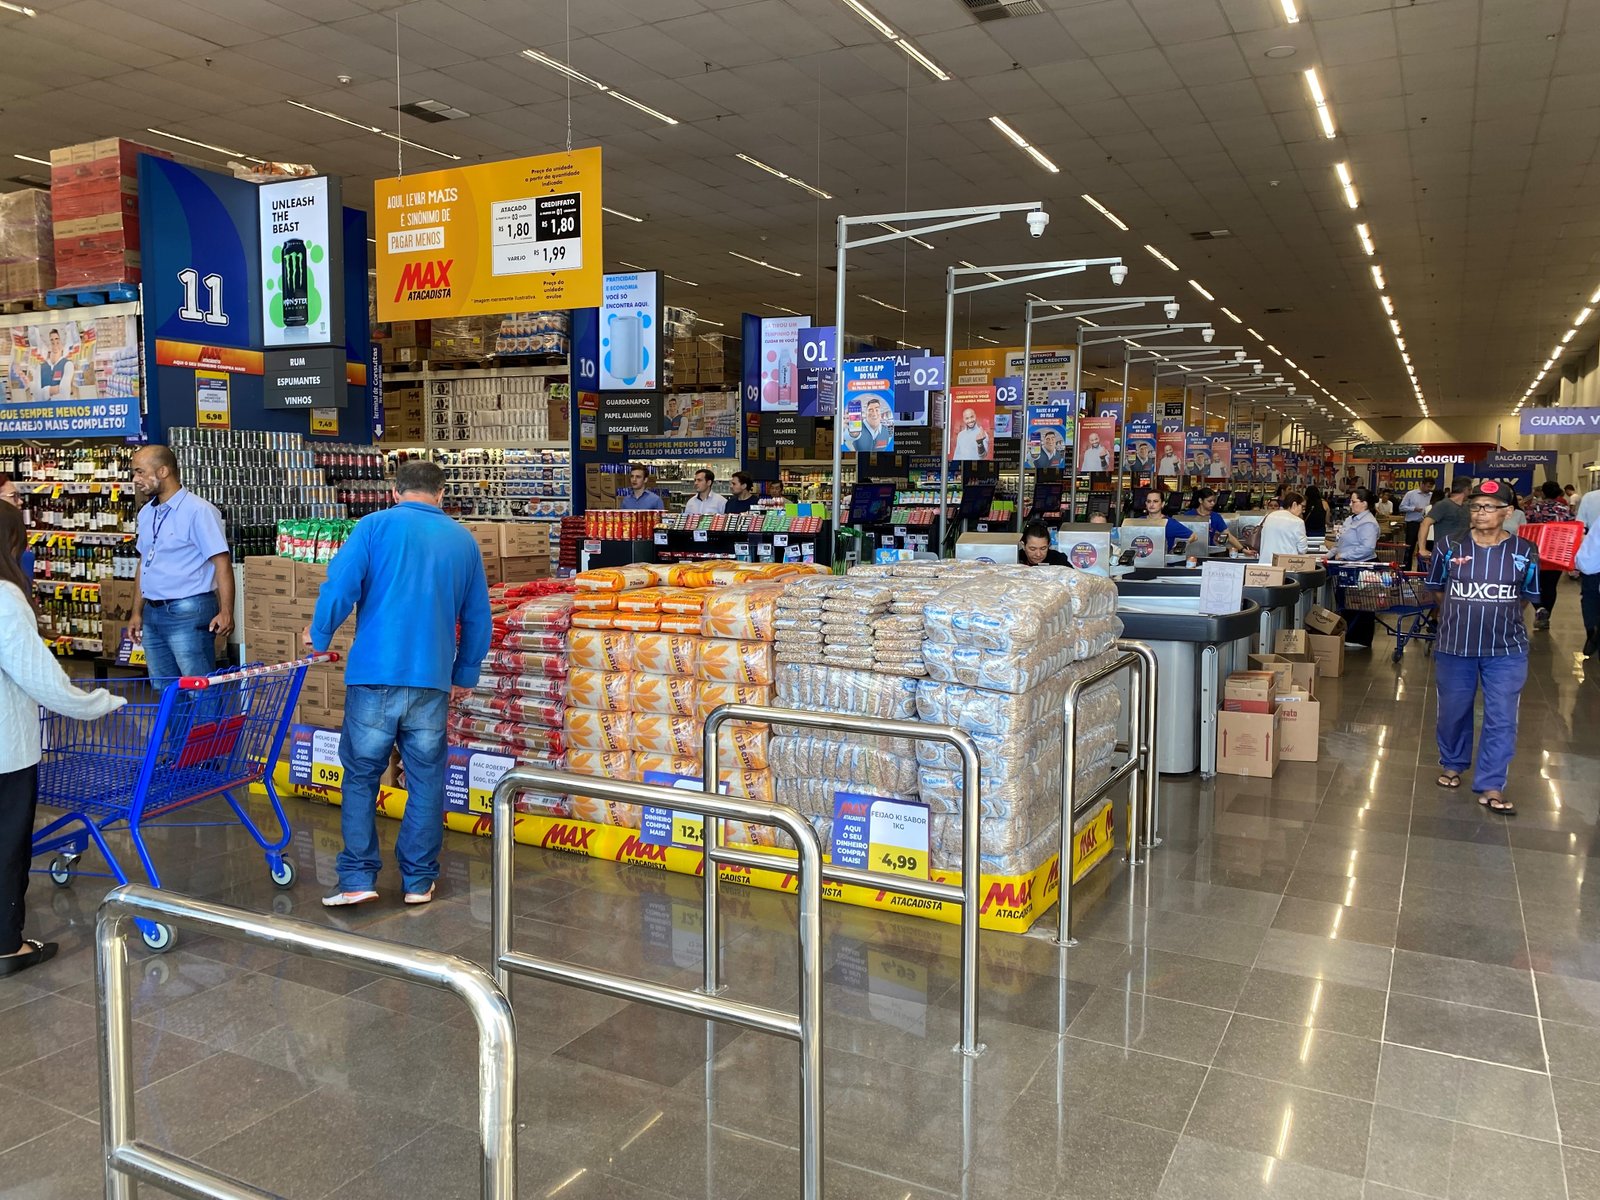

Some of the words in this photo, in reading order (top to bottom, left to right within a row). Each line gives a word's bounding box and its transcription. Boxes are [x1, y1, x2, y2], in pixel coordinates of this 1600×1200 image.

[406, 192, 426, 207] LEVAR
[428, 187, 458, 204] MAIS
[272, 195, 315, 211] UNLEASH
[540, 198, 575, 208] CREDIFFATO
[500, 204, 527, 214] ATACADO
[272, 211, 289, 223] THE
[442, 208, 451, 222] DE
[272, 222, 300, 234] BEAST
[507, 222, 529, 240] 1,80
[550, 216, 575, 236] 1,80
[391, 234, 414, 249] PAGAR
[415, 231, 441, 247] MENOS
[507, 254, 526, 262] VAREJO
[542, 245, 566, 263] 1,99
[394, 259, 454, 303] MAX
[606, 275, 638, 283] PRATICIDADE
[177, 267, 230, 325] 11
[407, 288, 451, 302] ATACADISTA
[606, 302, 633, 310] ENCONTRA
[803, 340, 828, 362] 01
[290, 357, 306, 367] RUM
[580, 357, 595, 378] 10
[979, 359, 996, 367] MAIS
[853, 365, 869, 373] BAIXE
[277, 375, 320, 387] ESPUMANTES
[913, 367, 939, 386] 02
[373, 386, 379, 396] de
[747, 384, 759, 402] 09
[996, 386, 1018, 402] 03
[285, 395, 312, 405] VINHOS
[606, 398, 650, 406] GUARDANAPOS
[20, 407, 54, 419] SEMPRE
[56, 405, 91, 418] MENOS
[92, 404, 107, 416] NO
[109, 403, 128, 415] SEU
[604, 412, 622, 420] PAPEL
[1101, 409, 1118, 420] 05
[206, 413, 223, 421] 6,98
[1530, 415, 1586, 426] GUARDA
[44, 418, 70, 431] MAIS
[71, 416, 126, 430] COMPLETO!
[318, 420, 333, 428] 7,49
[608, 424, 649, 434] DESCARTÁVEIS
[644, 441, 672, 449] SEMPRE
[673, 440, 699, 448] MENOS
[665, 447, 682, 455] MAIS
[683, 446, 725, 455] COMPLETO!
[1495, 454, 1522, 462] BALCÃO
[1425, 468, 1439, 479] DO
[1450, 582, 1518, 600] NUXCELL
[292, 759, 312, 767] DINHEIRO
[293, 765, 311, 773] COMPRA
[320, 768, 339, 782] 0,99
[446, 785, 469, 793] DINHEIRO
[446, 792, 468, 800] COMPRA
[655, 808, 667, 816] SEU
[837, 800, 869, 819] MAX
[644, 814, 672, 823] DINHEIRO
[903, 815, 927, 825] SABOR
[645, 821, 671, 831] COMPRA
[844, 824, 861, 833] AQUI
[892, 822, 905, 830] 1KG
[542, 823, 596, 850] MAX
[849, 833, 862, 841] SEU
[616, 835, 670, 862] MAX
[836, 839, 868, 850] DINHEIRO
[837, 847, 866, 858] COMPRA
[627, 858, 667, 871] ATACADISTA
[881, 852, 917, 871] 4,99
[720, 872, 751, 884] CADISTA
[980, 875, 1036, 915] MAX
[890, 896, 942, 911] ATACADISTA
